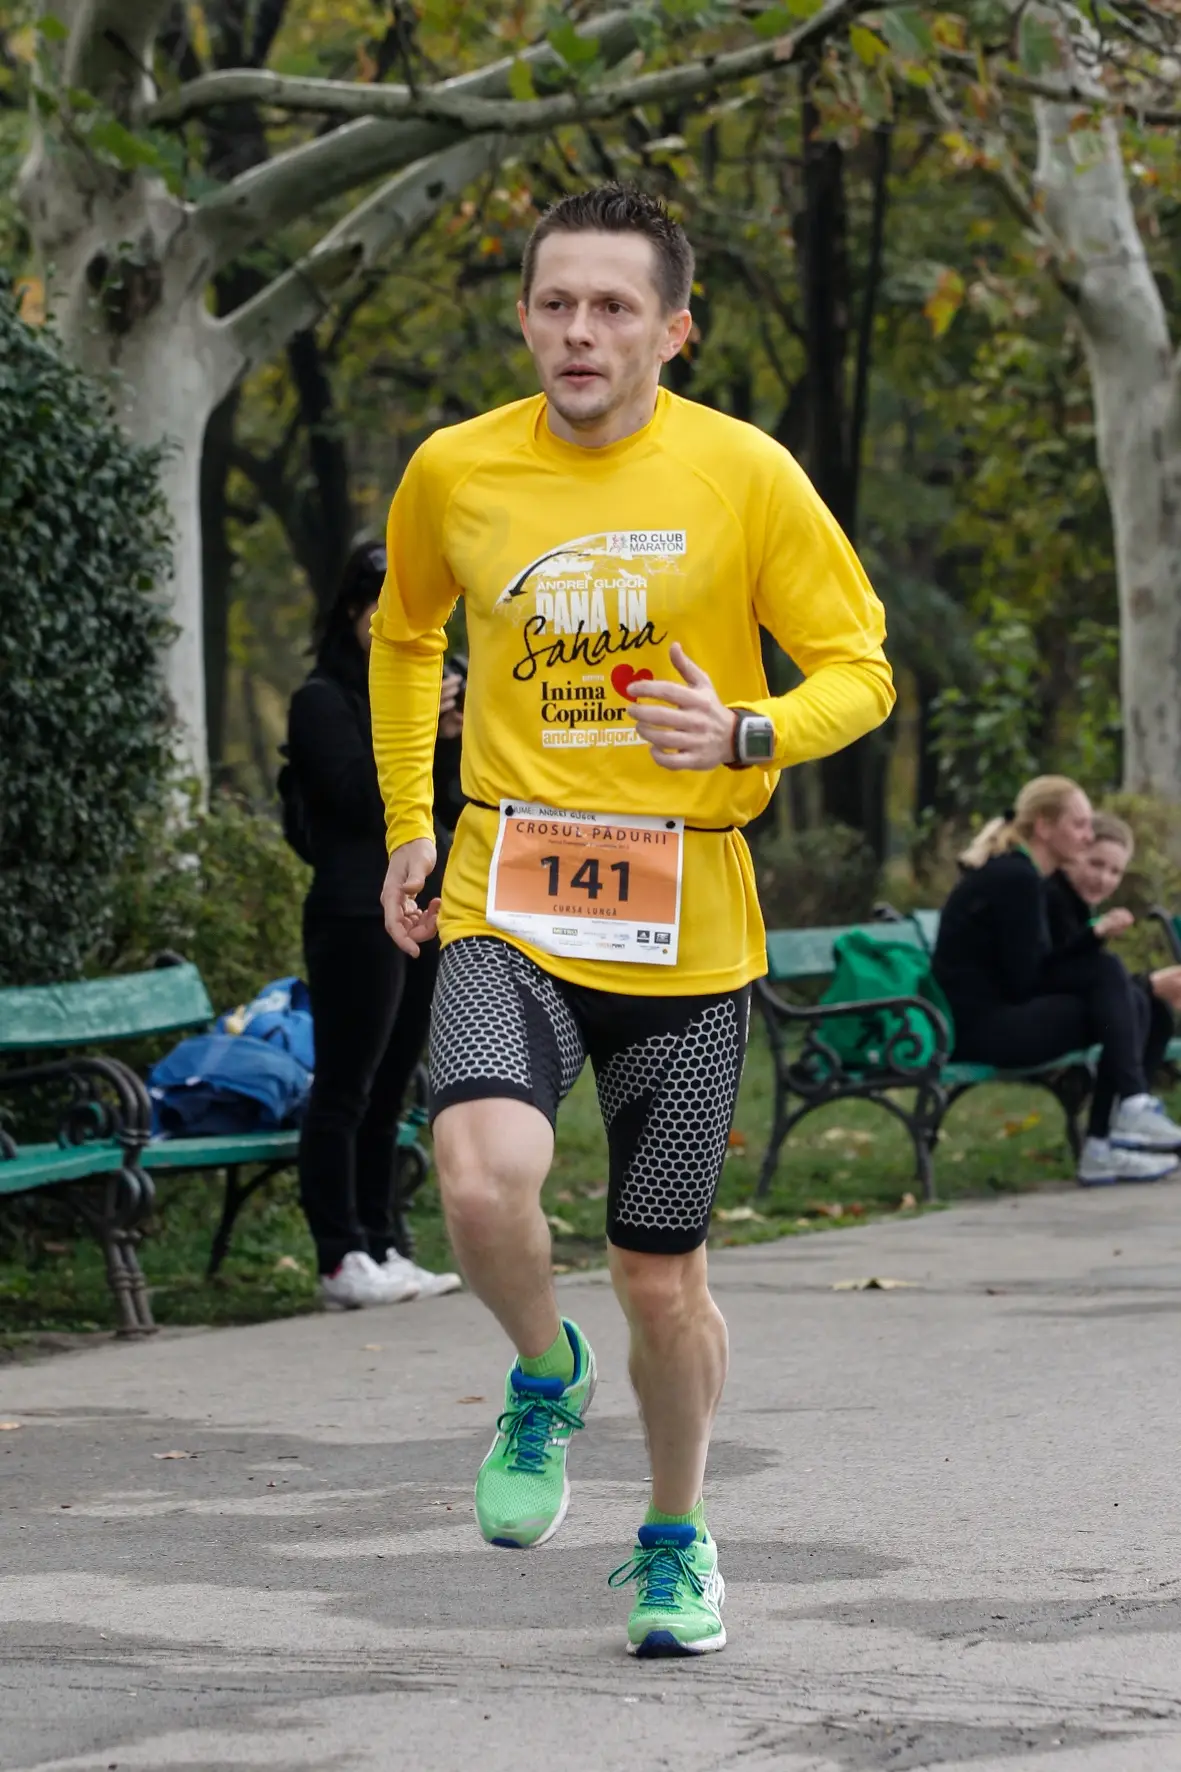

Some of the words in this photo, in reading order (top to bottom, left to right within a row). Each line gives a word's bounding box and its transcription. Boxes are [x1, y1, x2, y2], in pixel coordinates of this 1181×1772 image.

[629, 533, 648, 542] RO
[651, 533, 684, 542] CLUB
[629, 542, 684, 552] MARATON
[537, 579, 589, 591] ANDREI
[513, 615, 667, 681] Sahara
[541, 681, 606, 701] Inima
[541, 702, 627, 729] Copiilor
[516, 821, 583, 838] CROSUL
[540, 855, 630, 902] 141
[553, 904, 582, 913] CURSA
